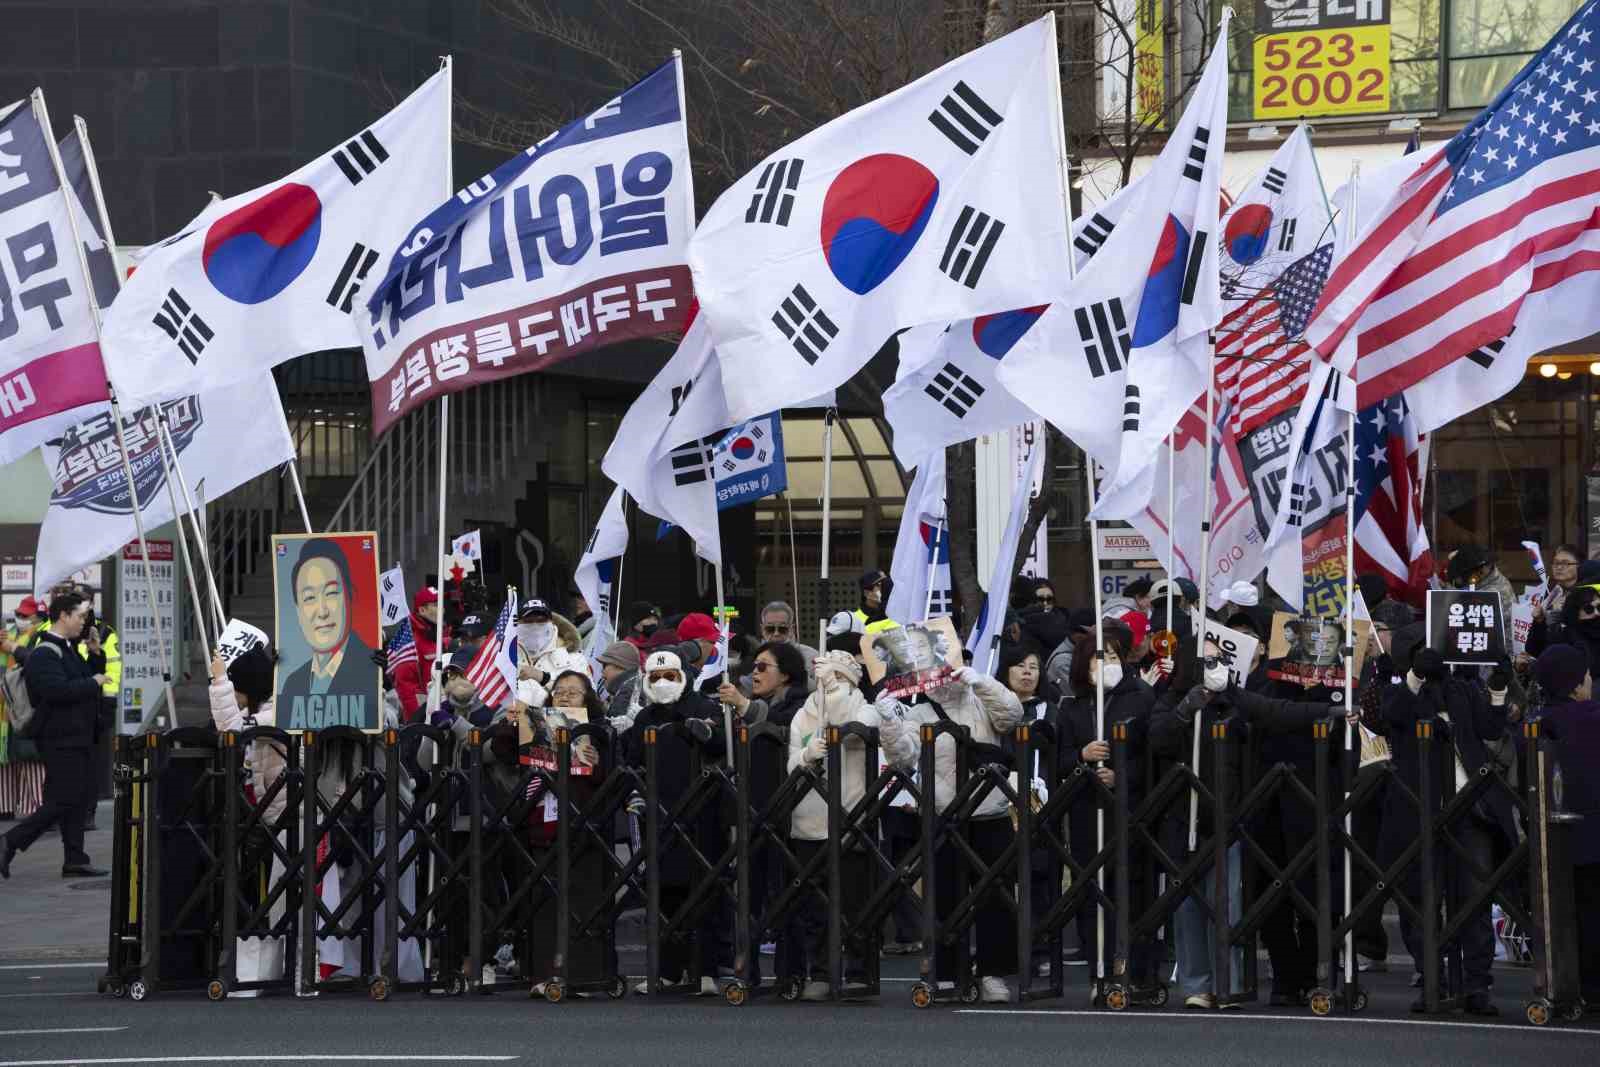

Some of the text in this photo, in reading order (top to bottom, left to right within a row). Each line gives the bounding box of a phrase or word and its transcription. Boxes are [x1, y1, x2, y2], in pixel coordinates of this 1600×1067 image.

[1264, 33, 1375, 71] 523-
[1262, 68, 1384, 108] 2002
[1103, 576, 1128, 593] 6F
[1448, 603, 1495, 628] 윤석열
[1457, 631, 1488, 653] 무죄
[290, 694, 367, 730] AGAIN
